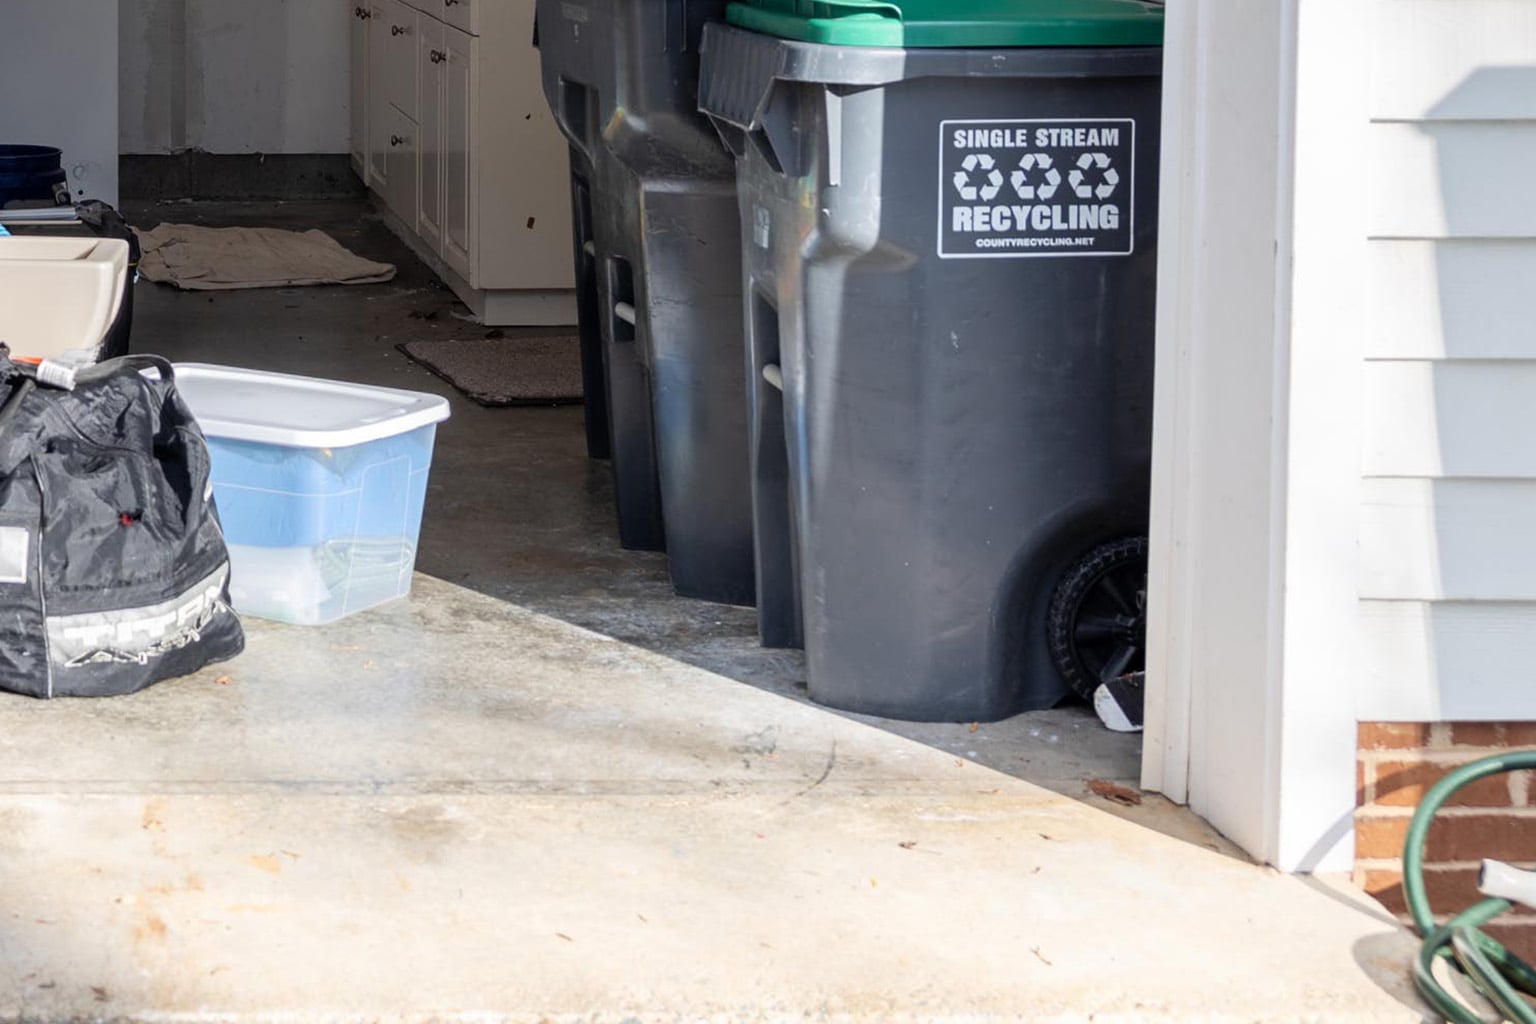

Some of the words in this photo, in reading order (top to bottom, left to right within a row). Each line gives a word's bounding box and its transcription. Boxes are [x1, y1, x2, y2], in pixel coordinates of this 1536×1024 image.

[953, 129, 1027, 148] SINGLE
[1035, 128, 1119, 147] STREAM
[952, 204, 1120, 232] RECYCLING
[975, 237, 1096, 248] COUNTYRECYCLING.NET
